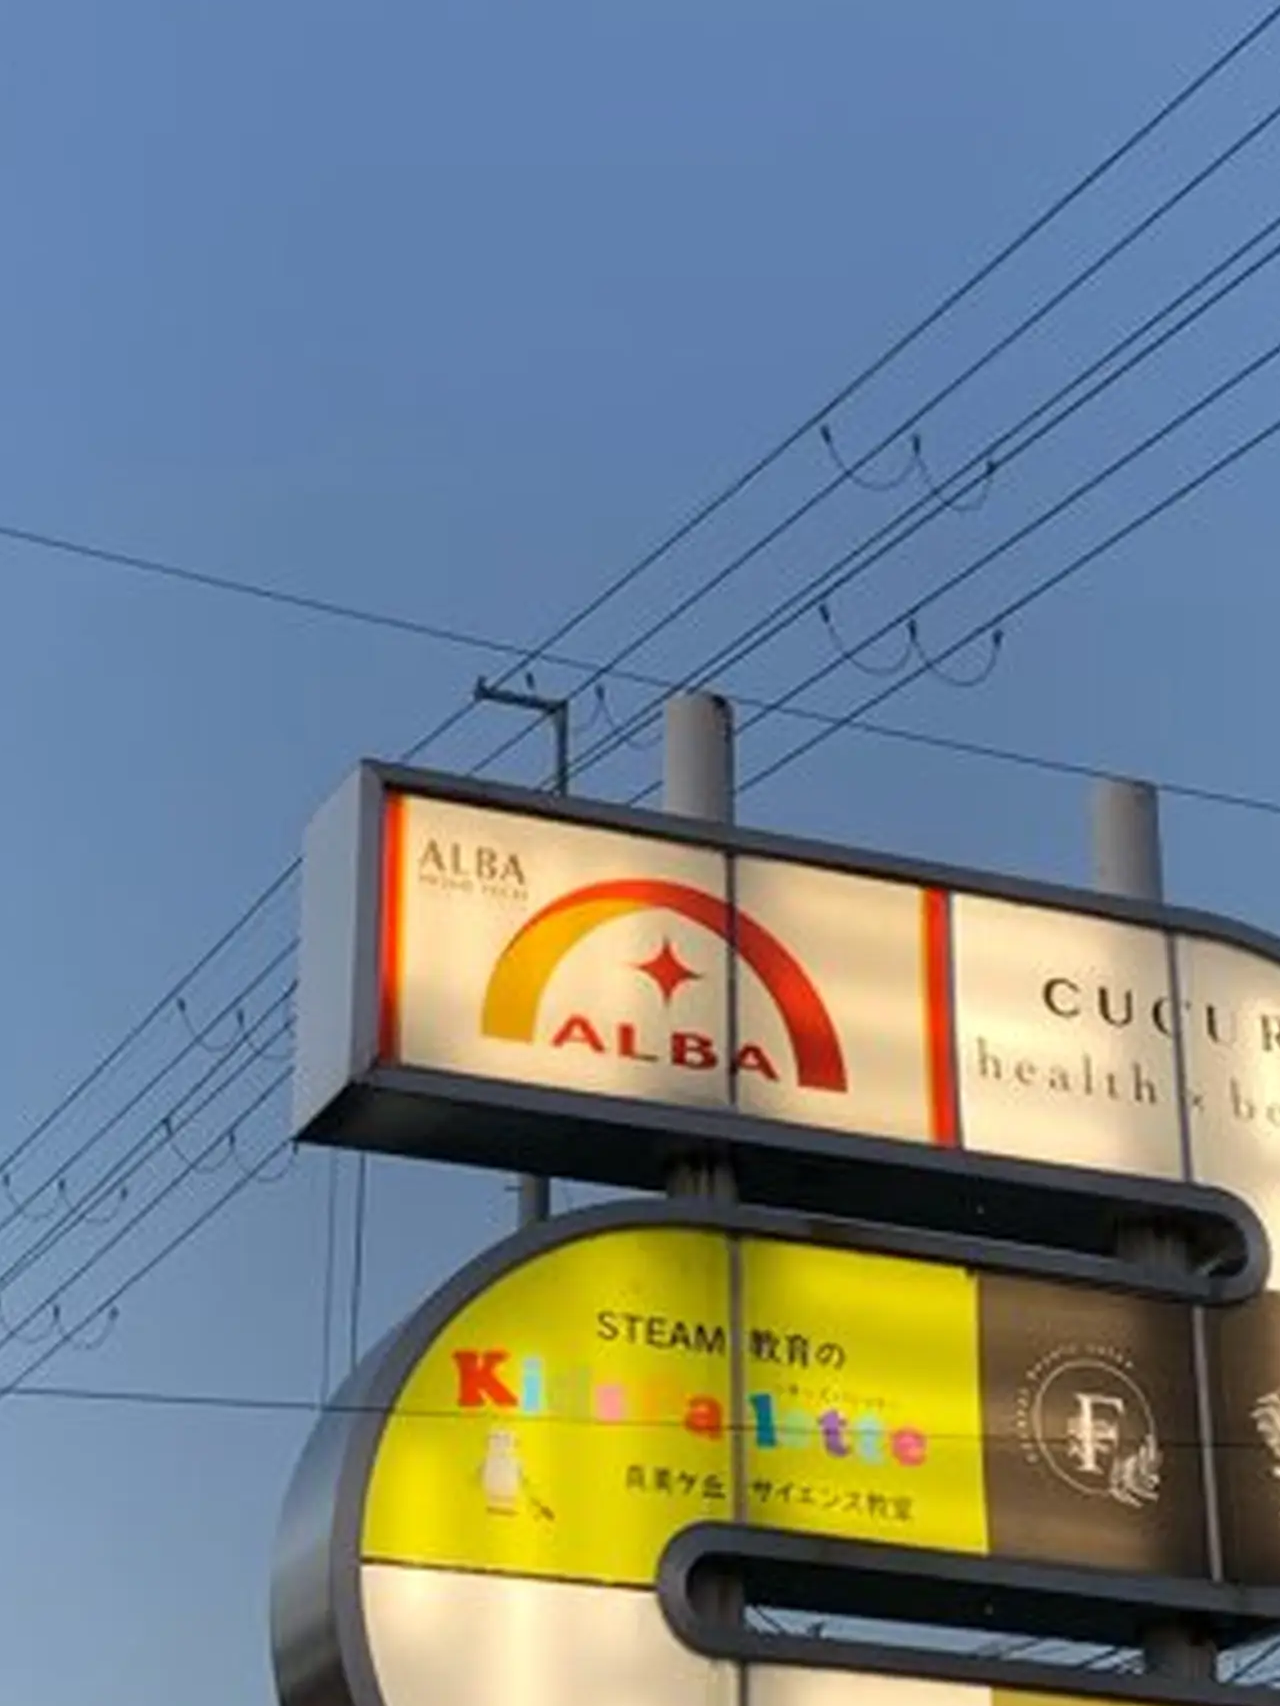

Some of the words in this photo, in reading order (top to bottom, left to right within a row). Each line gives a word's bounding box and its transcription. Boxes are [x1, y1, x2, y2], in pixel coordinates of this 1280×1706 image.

[418, 837, 526, 886] ALBA
[552, 1014, 780, 1082] ALBA
[976, 1036, 1157, 1104] health
[597, 1311, 726, 1357] STEAM
[749, 1331, 846, 1370] 教育の
